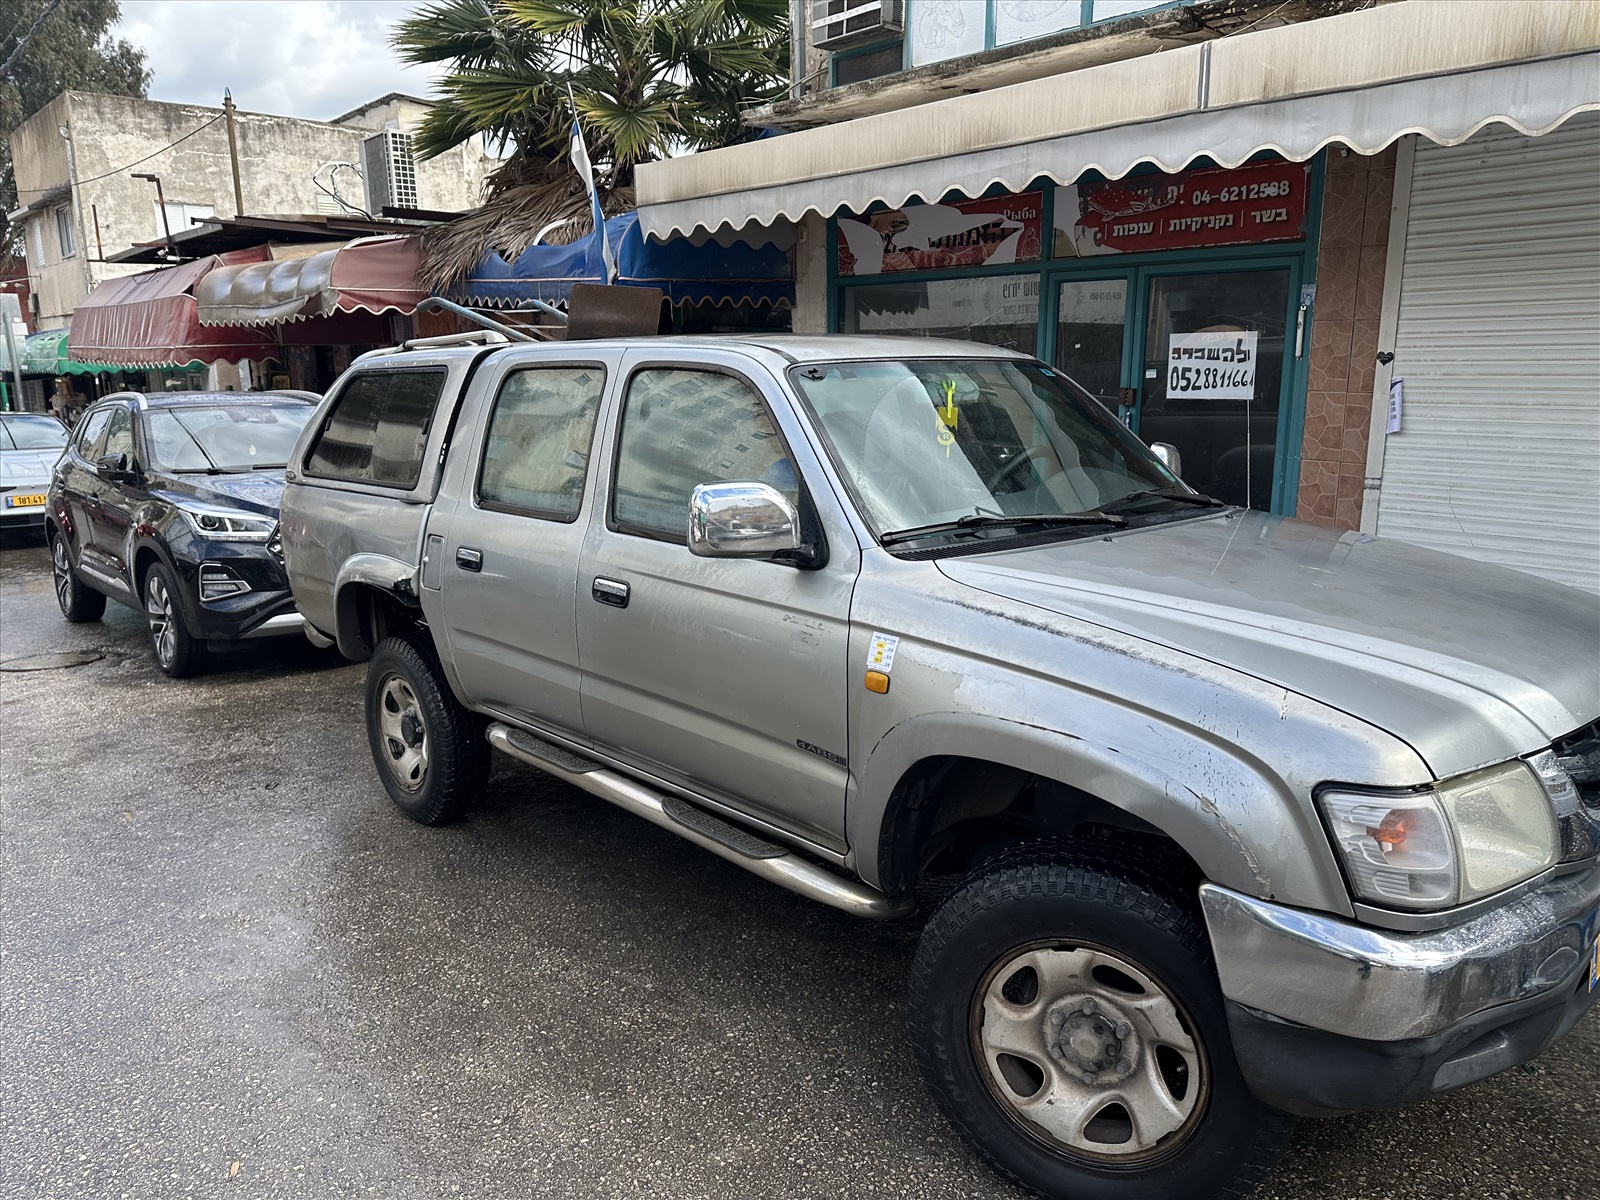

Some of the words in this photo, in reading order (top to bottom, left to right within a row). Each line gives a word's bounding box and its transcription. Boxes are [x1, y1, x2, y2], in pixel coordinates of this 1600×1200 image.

[1168, 213, 1234, 232] נקניקיות
[1250, 208, 1288, 223] בשר
[1112, 222, 1154, 237] עופות
[1171, 337, 1250, 363] להשכרה
[1170, 366, 1254, 392] 0528811661
